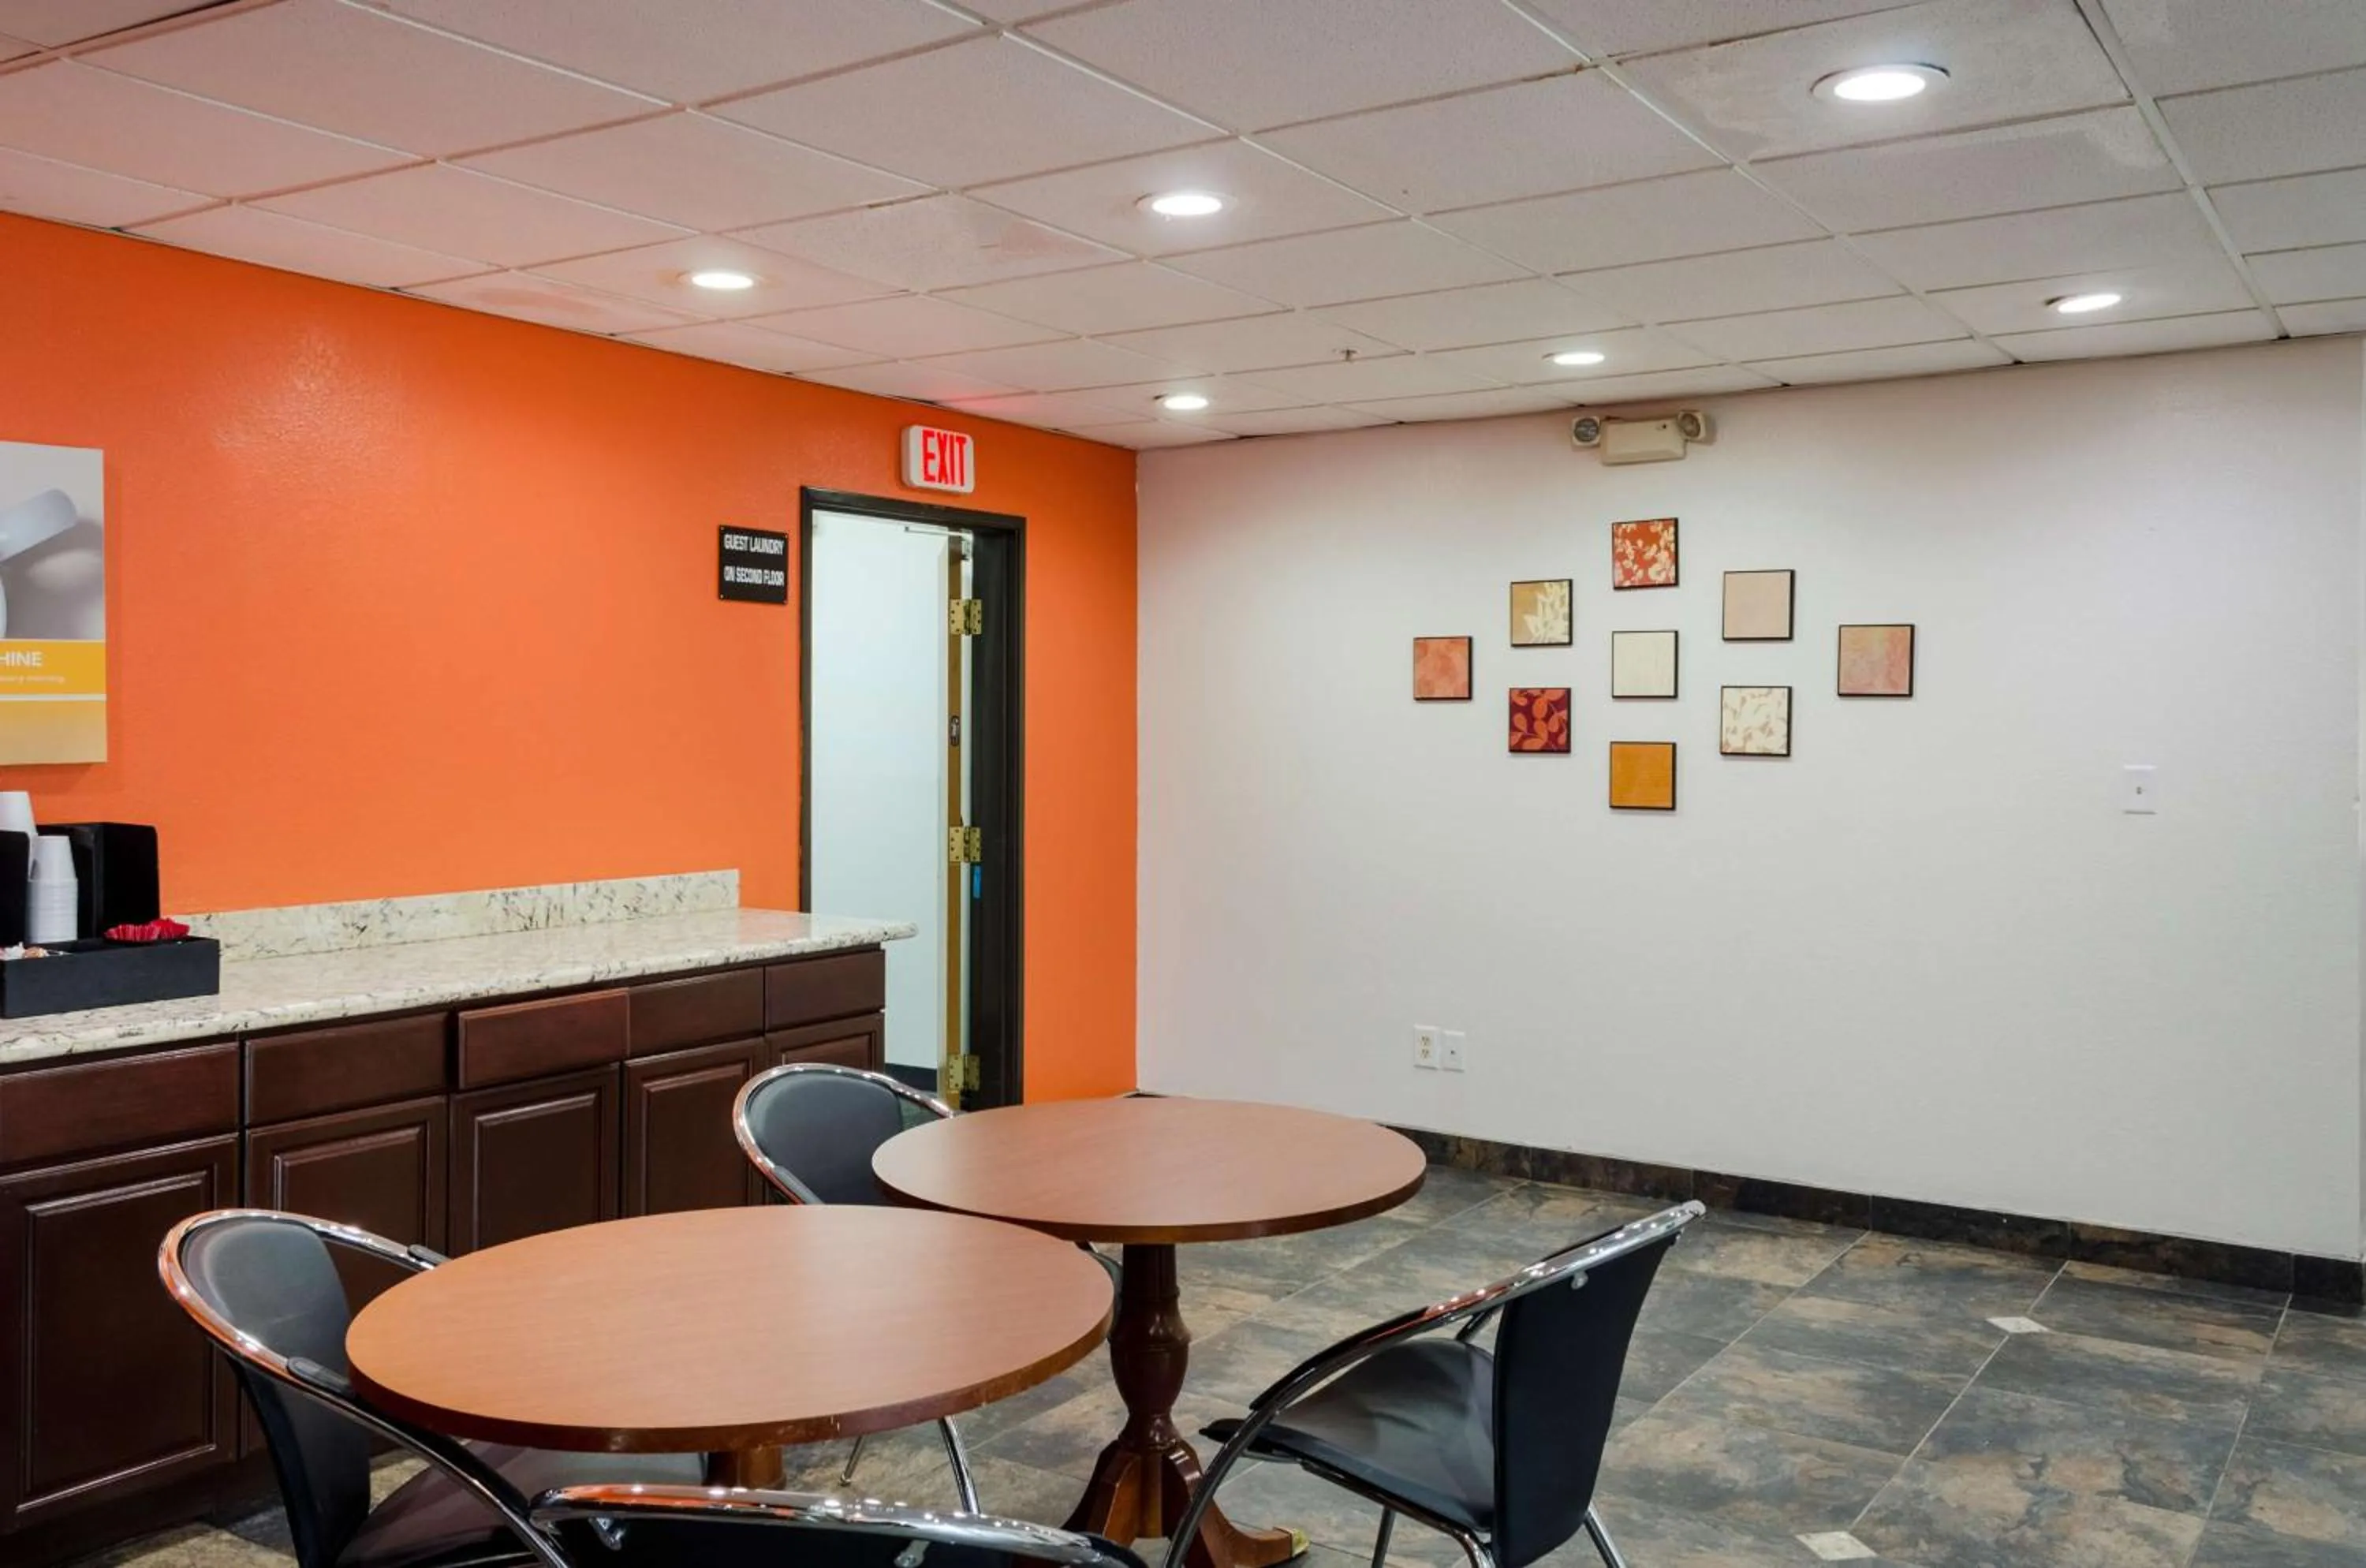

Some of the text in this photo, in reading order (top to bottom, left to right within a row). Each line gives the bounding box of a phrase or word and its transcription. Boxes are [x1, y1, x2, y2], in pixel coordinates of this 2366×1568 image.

[923, 429, 967, 487] EXIT
[724, 534, 784, 555] GUEST LAUNDRY
[724, 566, 785, 586] ON SECOND FLOOR
